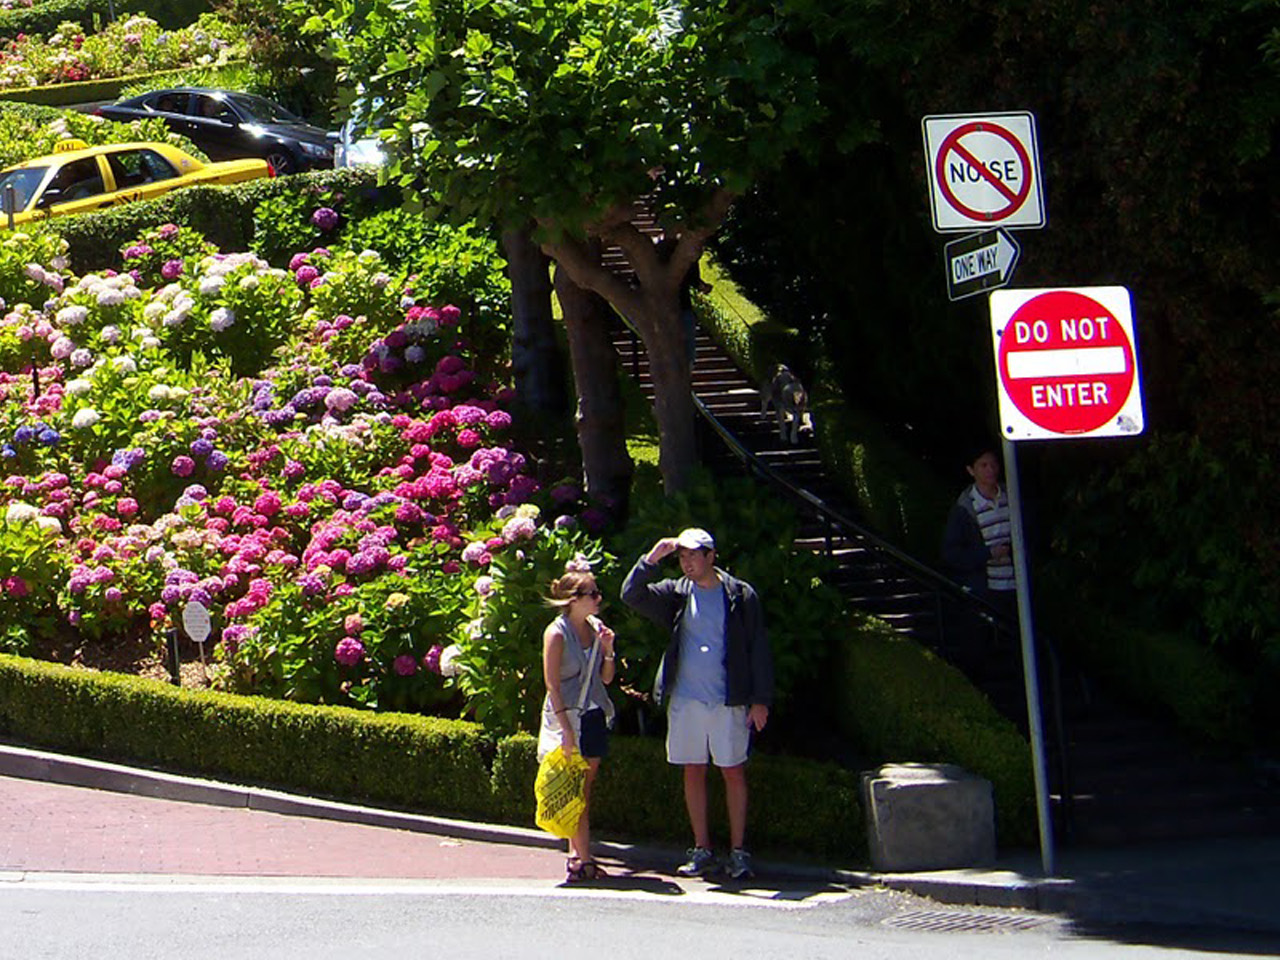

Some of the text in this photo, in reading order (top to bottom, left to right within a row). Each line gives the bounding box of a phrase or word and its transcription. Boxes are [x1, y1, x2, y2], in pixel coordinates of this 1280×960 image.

[954, 246, 998, 280] ONE WAY
[1014, 316, 1109, 344] DO NOT
[1030, 381, 1109, 408] ENTER
